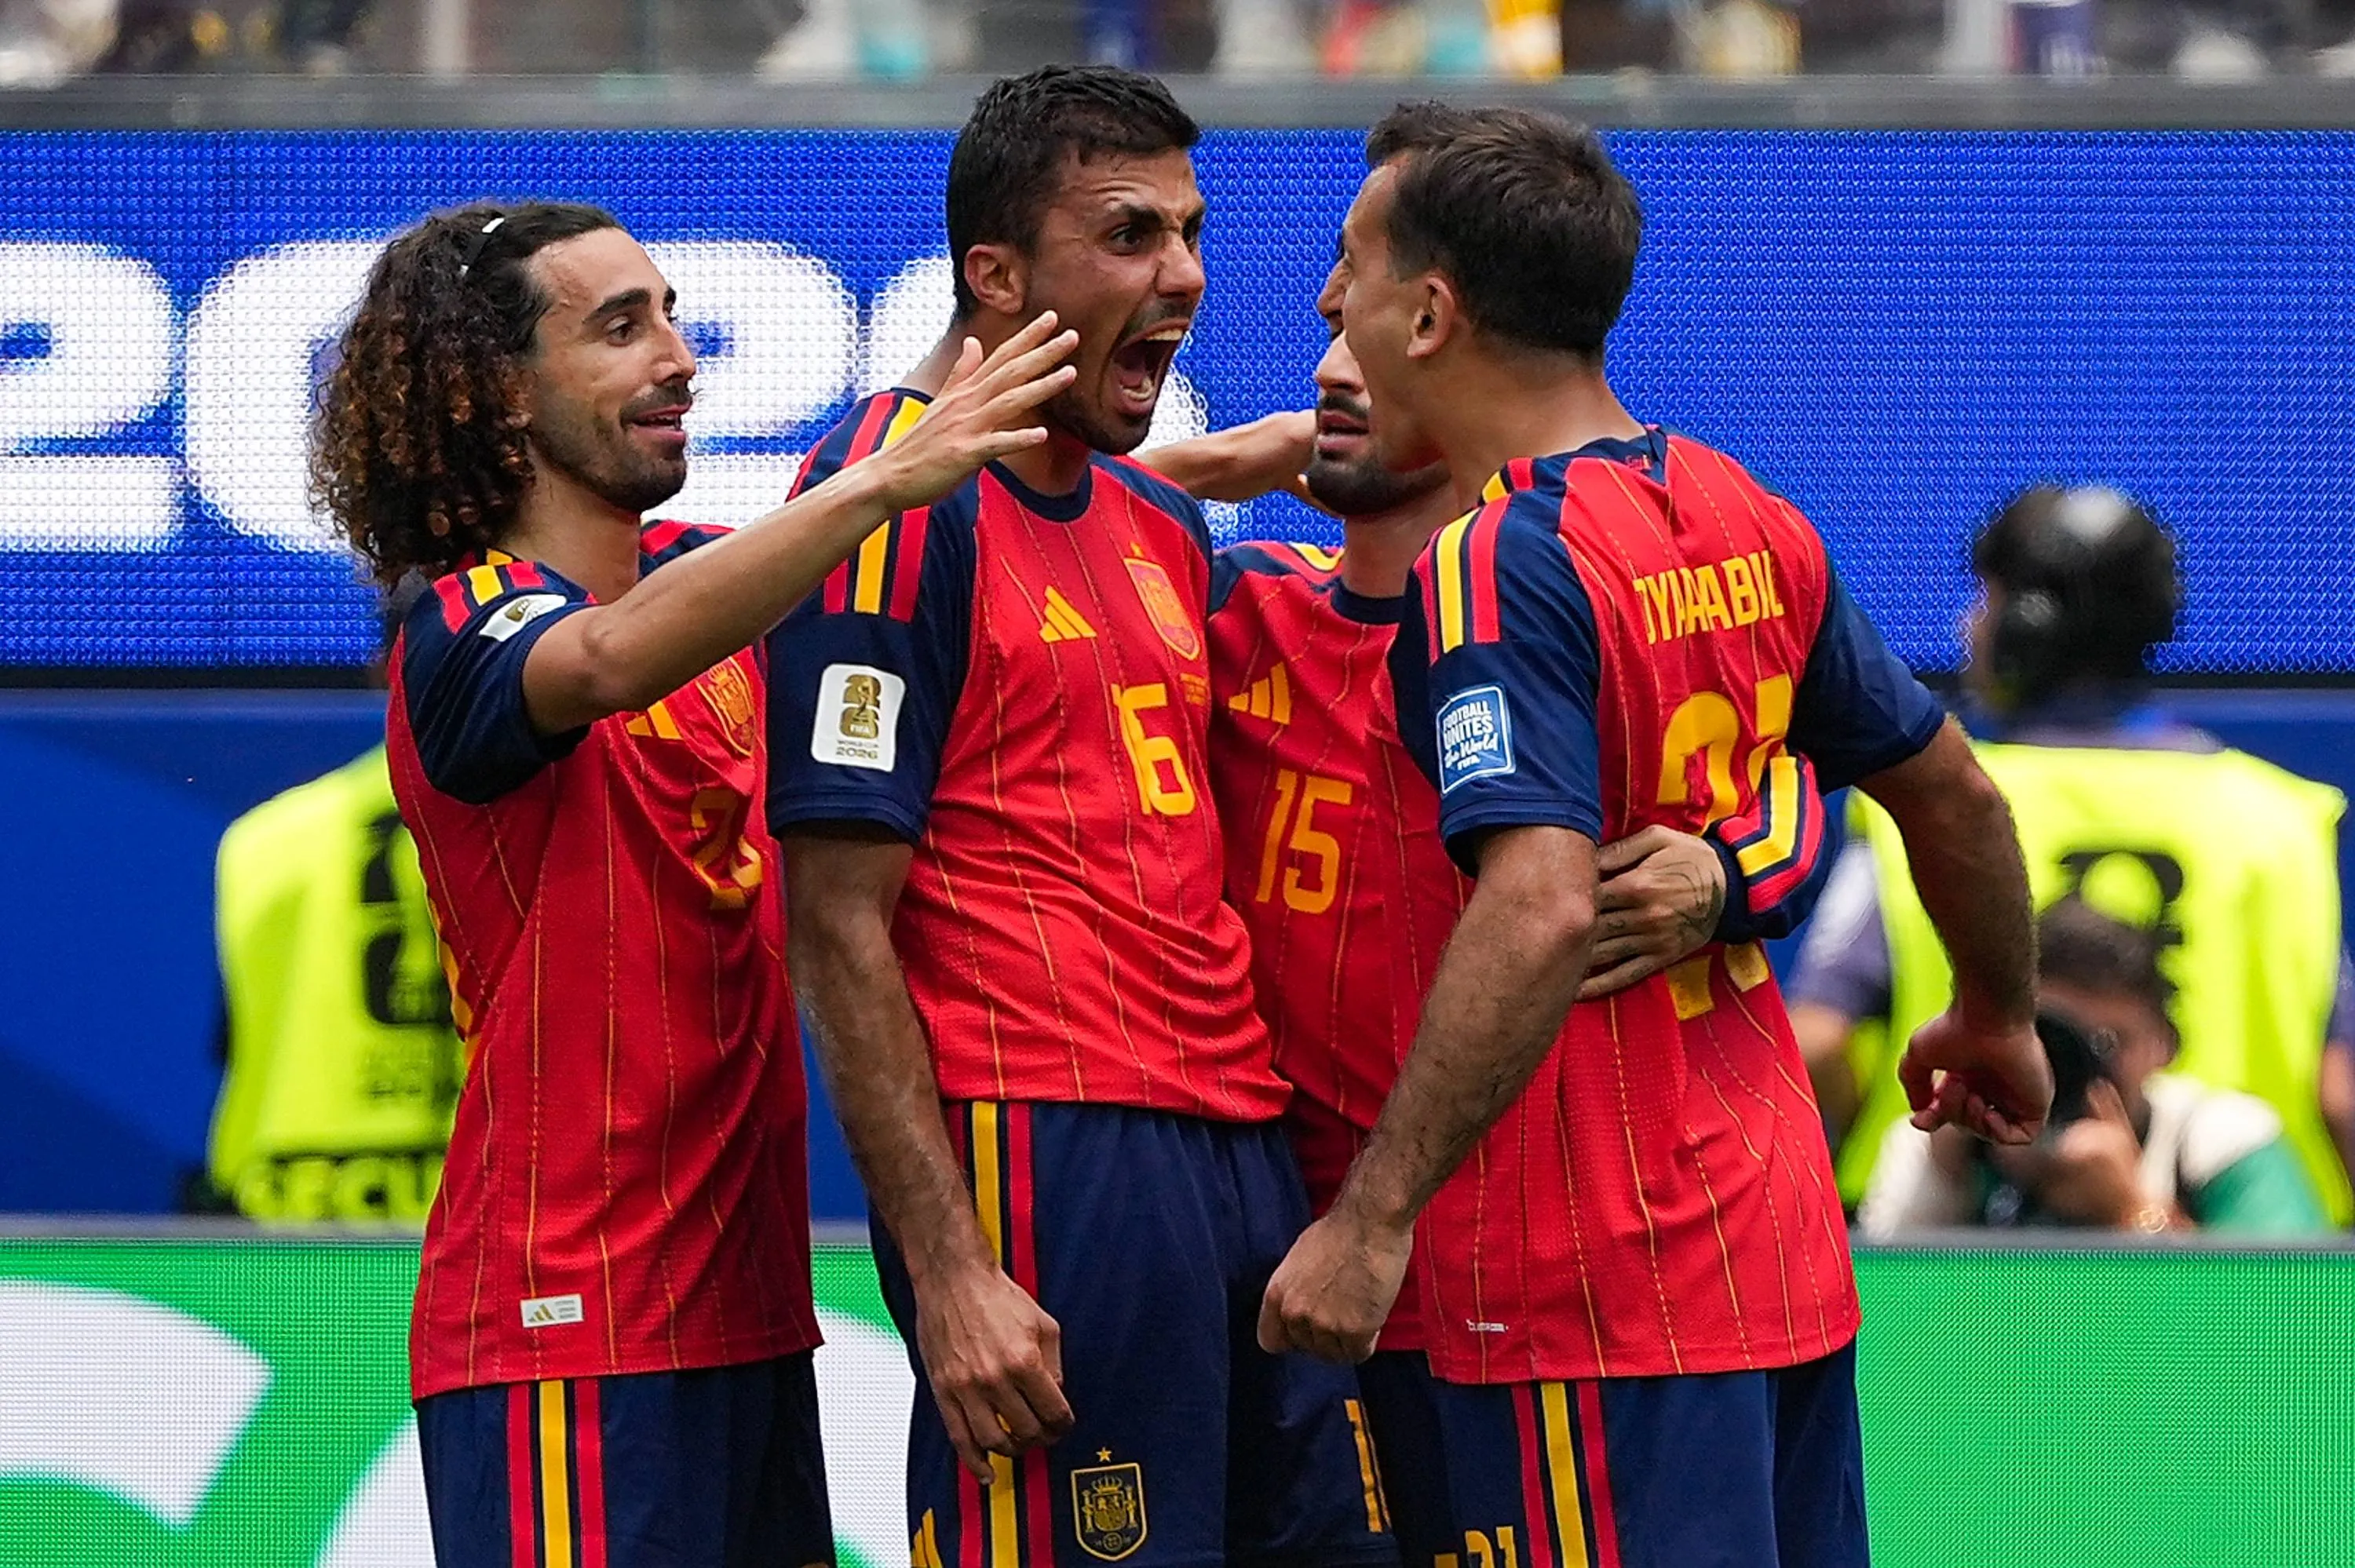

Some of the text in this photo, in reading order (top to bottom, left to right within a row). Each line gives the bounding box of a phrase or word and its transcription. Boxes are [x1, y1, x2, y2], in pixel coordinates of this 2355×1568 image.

[1444, 700, 1492, 727] FOOTBALL
[1111, 683, 1196, 815] 16
[1444, 715, 1495, 750] UNITES
[835, 746, 878, 760] 2026
[1255, 768, 1353, 914] 15
